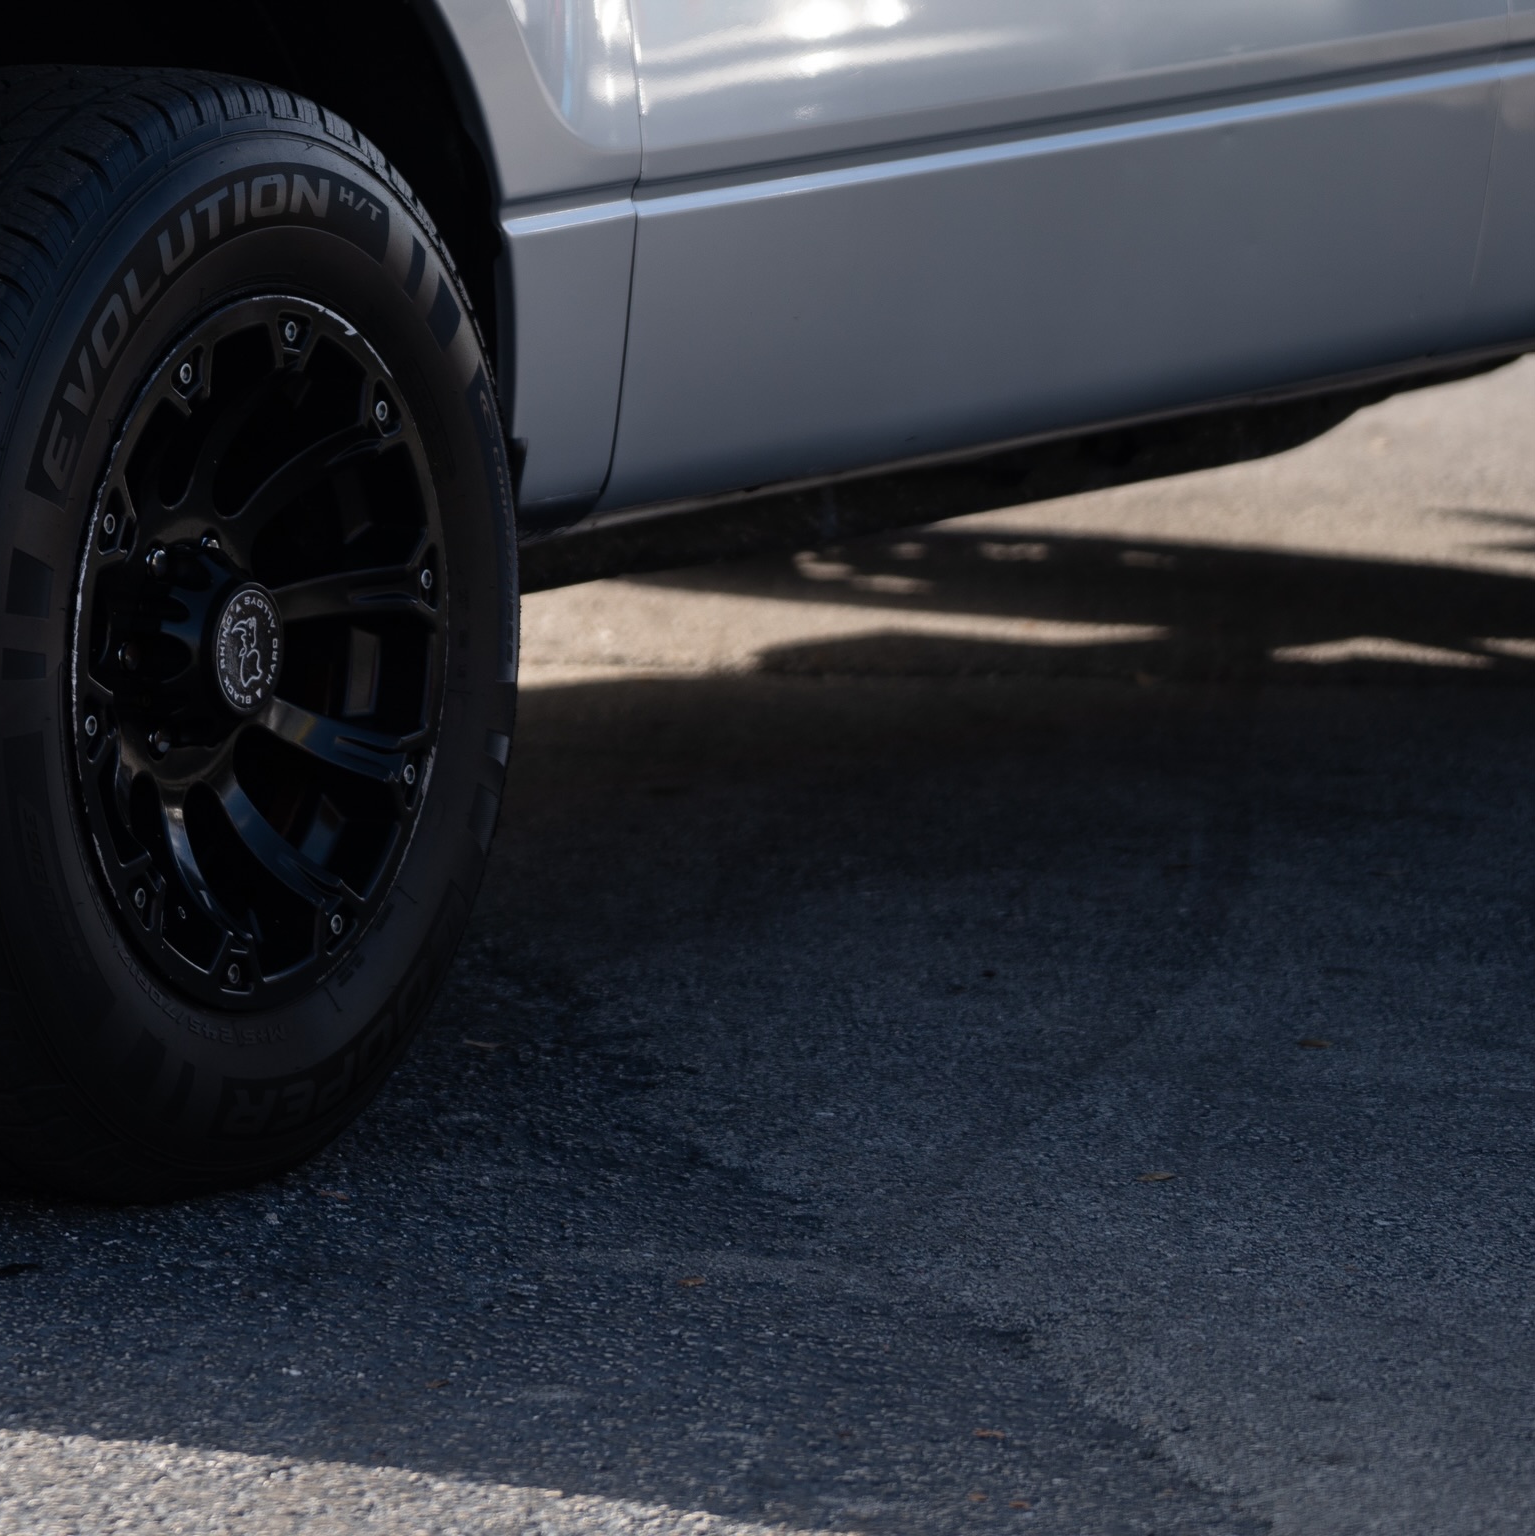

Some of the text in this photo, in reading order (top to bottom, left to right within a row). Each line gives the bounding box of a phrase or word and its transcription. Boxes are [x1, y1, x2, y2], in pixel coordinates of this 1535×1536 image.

[41, 172, 332, 492] EVOLUTION
[338, 186, 382, 223] H/T
[218, 615, 253, 705] BLACK RHINO
[243, 595, 280, 685] HARD ALLOYS
